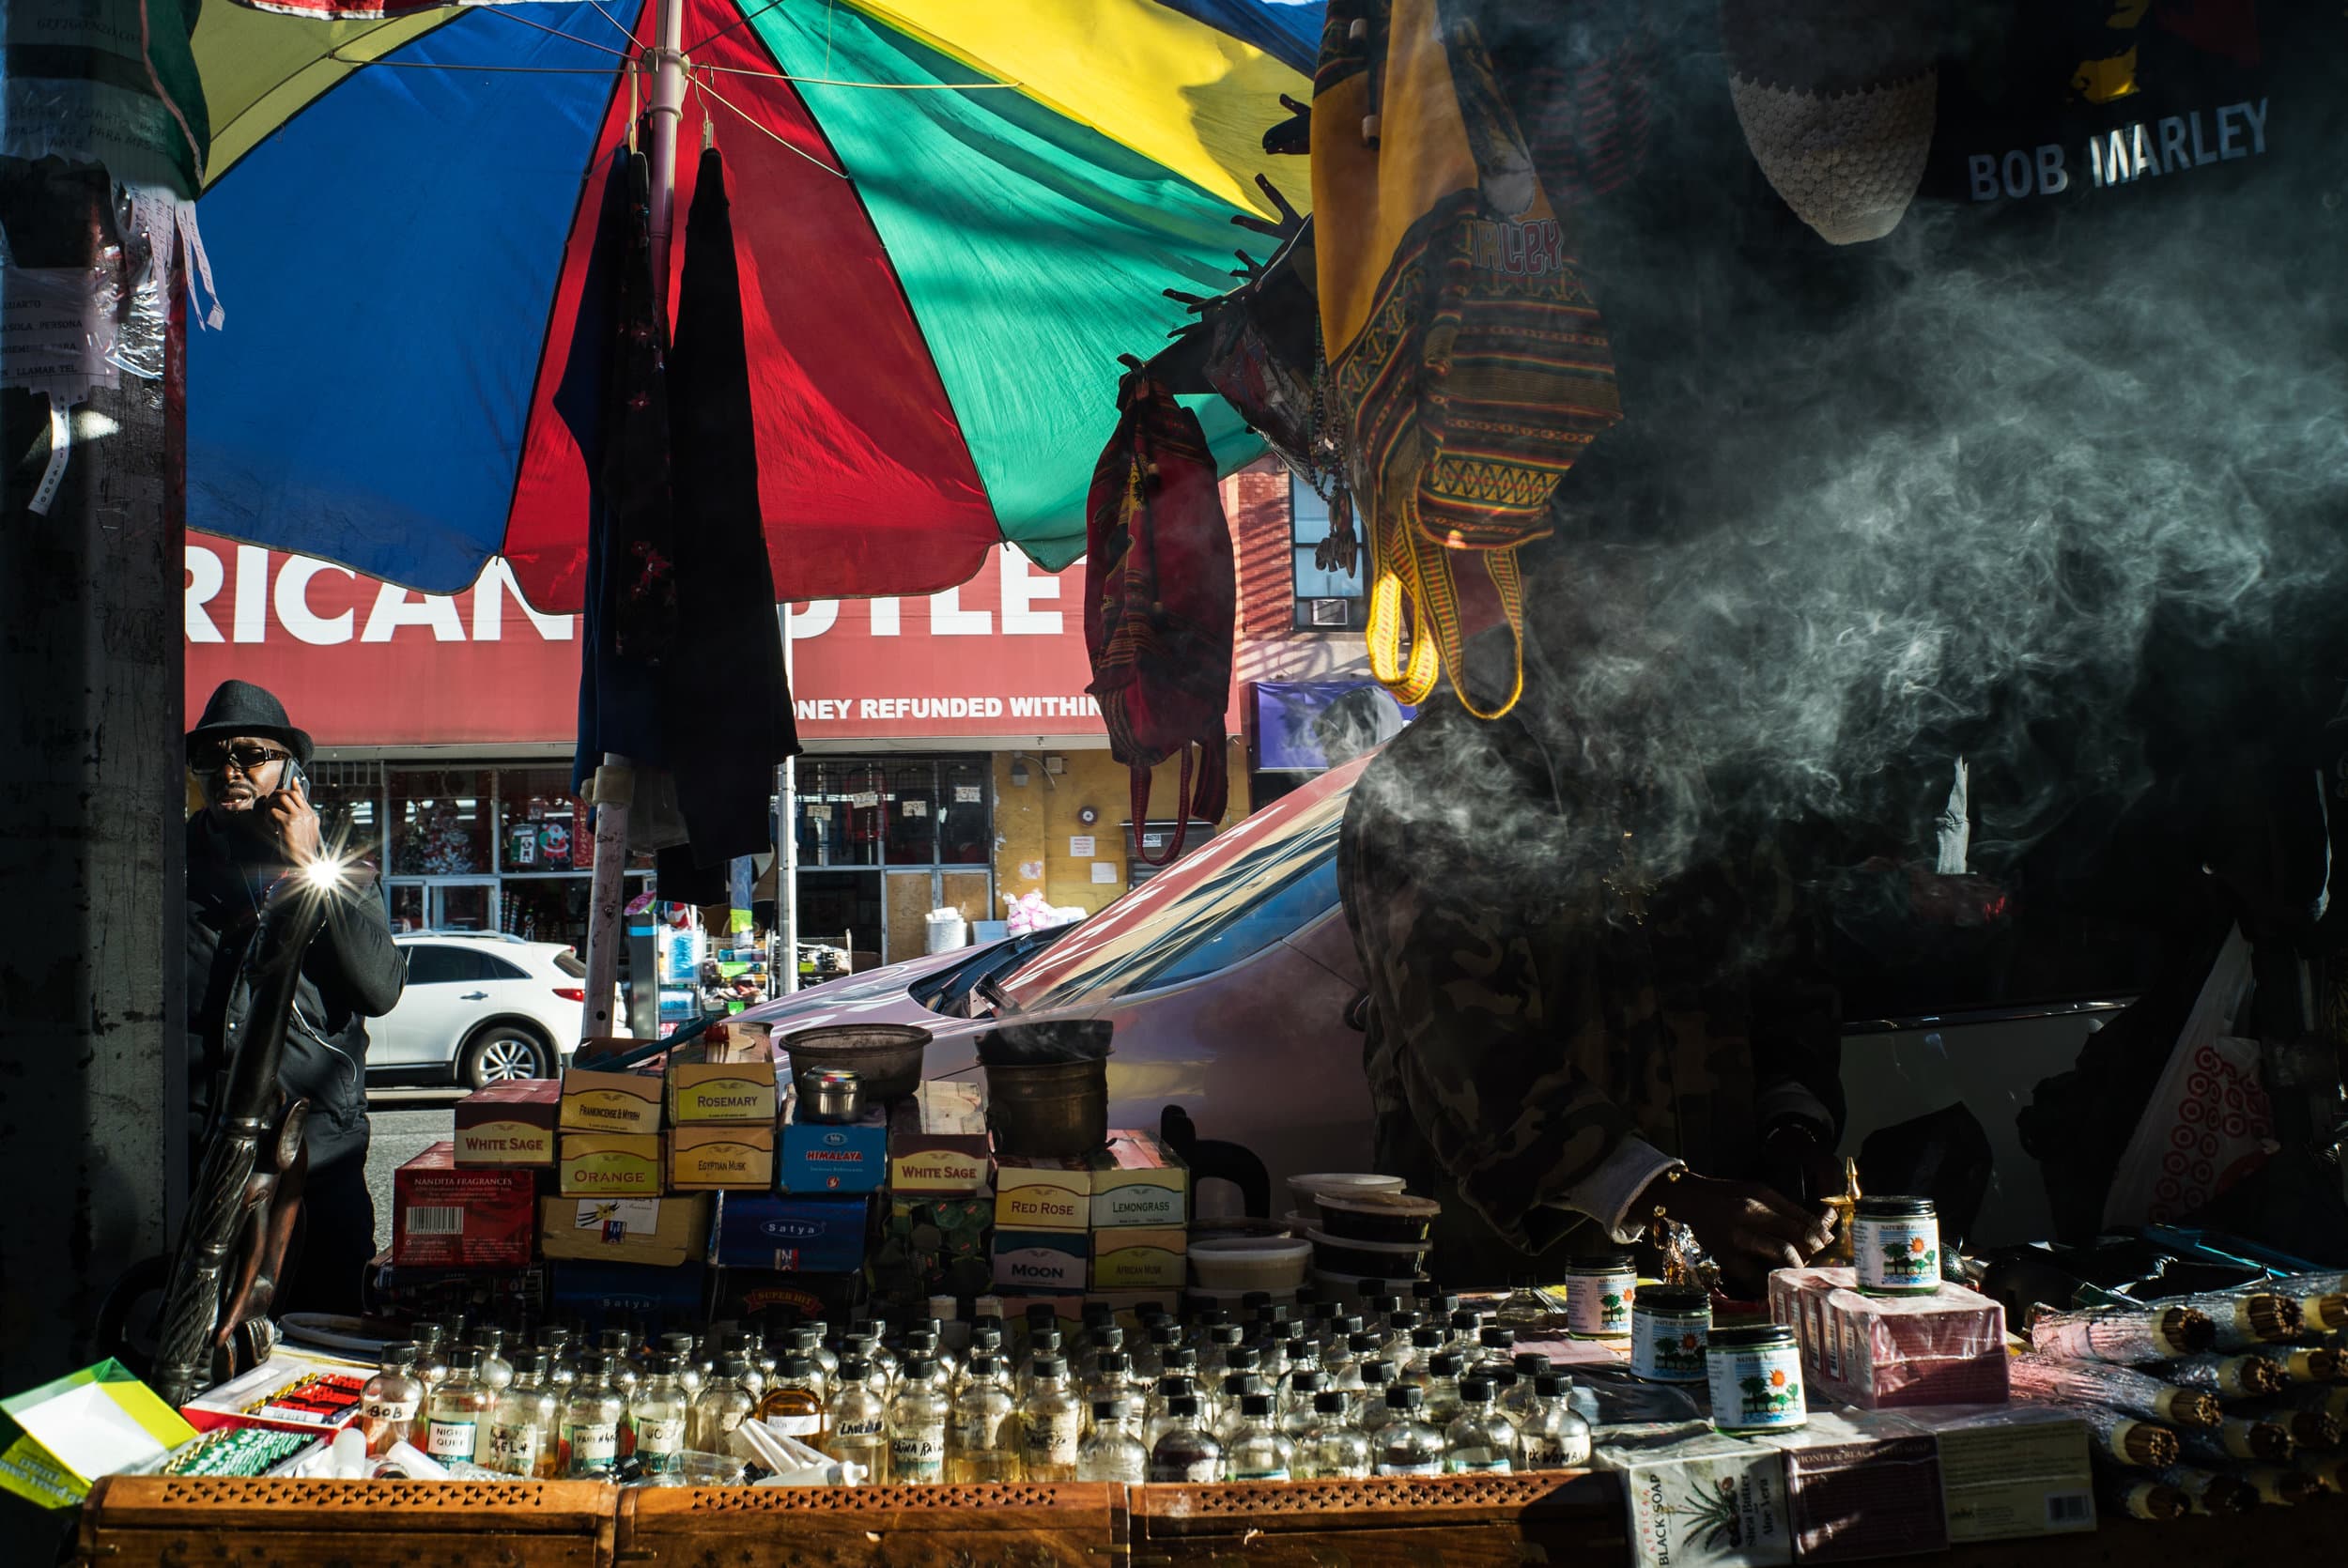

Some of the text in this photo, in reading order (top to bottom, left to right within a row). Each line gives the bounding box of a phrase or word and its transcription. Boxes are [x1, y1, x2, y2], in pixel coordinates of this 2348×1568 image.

[1969, 97, 2269, 202] BOB MARLEY
[17, 366, 55, 377] LLAMAR
[794, 699, 853, 720] NEY
[859, 698, 1002, 719] REFUNDED
[697, 1095, 759, 1108] ROSEMARY
[466, 1137, 544, 1151] WHITE SAGE
[805, 1150, 864, 1162] HIMALAYA
[698, 1160, 747, 1172] EGYPTIAN MUSK
[902, 1165, 978, 1179] WHITE SAGE
[413, 1177, 514, 1187] NANDITA FRAGRANCES
[574, 1169, 646, 1183] ORANGE
[1011, 1201, 1074, 1216] RED ROSE
[1112, 1201, 1170, 1213] LEMONGRASS
[766, 1222, 815, 1236] Satya
[1011, 1264, 1064, 1278] MOON
[603, 1298, 650, 1310] Satya
[367, 1405, 403, 1420] BOB
[893, 1441, 918, 1454] CHINA
[1797, 1453, 1832, 1466] HONEY
[1740, 1473, 1757, 1547] Shea Butter
[1642, 1488, 1657, 1553] AFRICAN
[1650, 1473, 1670, 1566] BLACK SOAP
[1762, 1508, 1774, 1536] Aloe
